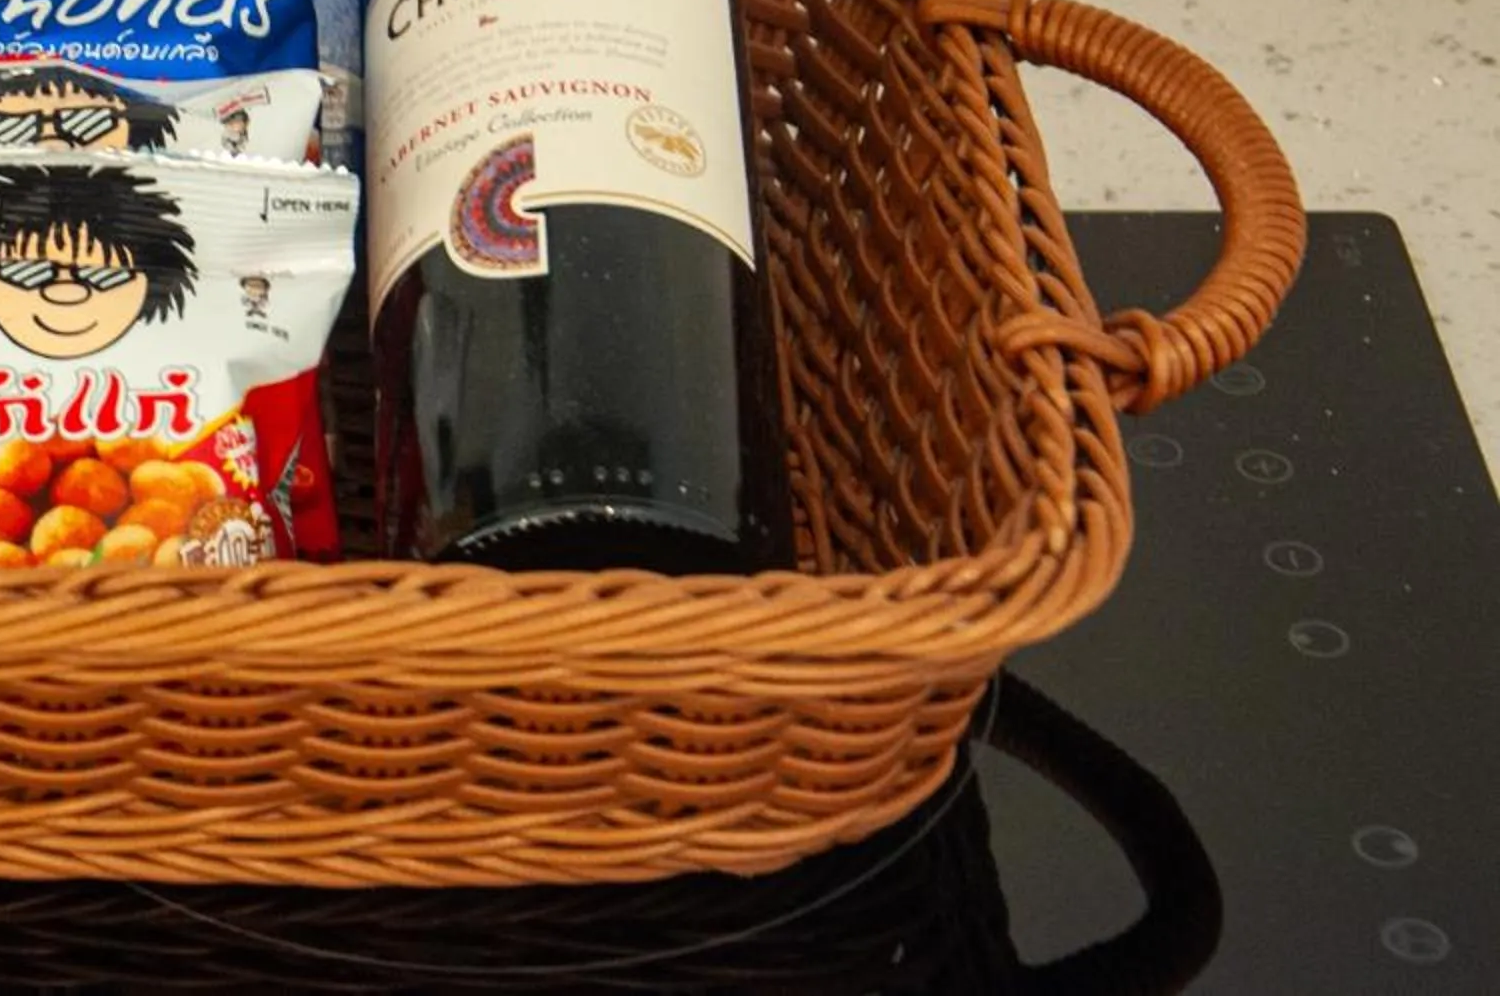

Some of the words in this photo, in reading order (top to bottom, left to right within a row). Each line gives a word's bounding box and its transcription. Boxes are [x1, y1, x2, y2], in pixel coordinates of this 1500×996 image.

[487, 79, 652, 104] SAUVIGNON
[486, 107, 593, 135] Collection
[271, 198, 311, 213] OPEN
